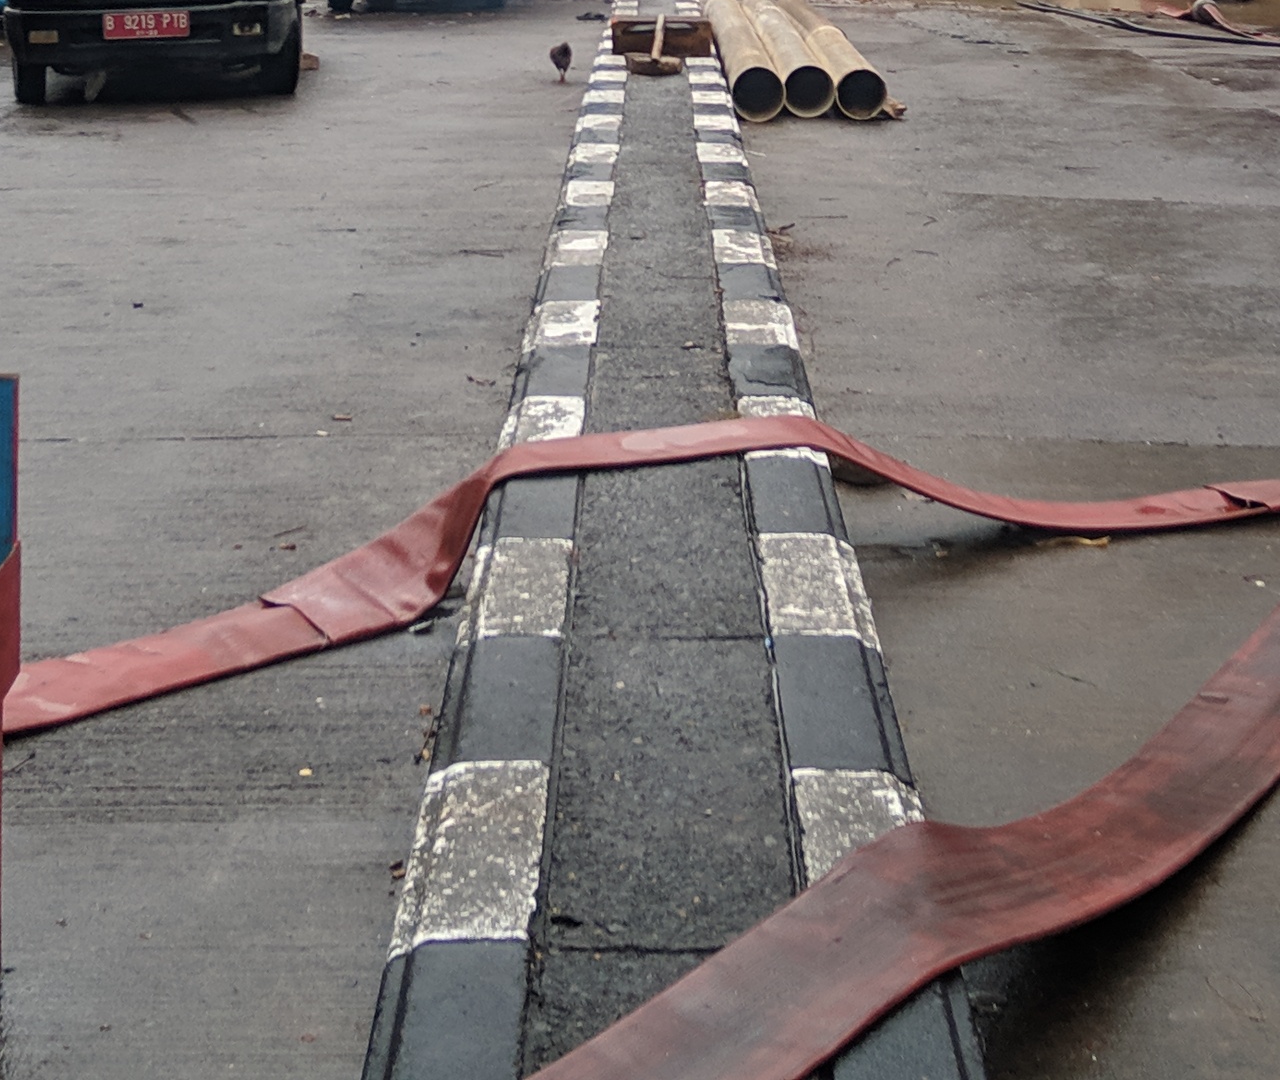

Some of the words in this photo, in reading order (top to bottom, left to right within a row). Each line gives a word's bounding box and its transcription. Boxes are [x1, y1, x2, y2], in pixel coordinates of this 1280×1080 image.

[105, 15, 115, 31] B
[123, 14, 156, 30] 9219
[161, 13, 188, 28] PTB
